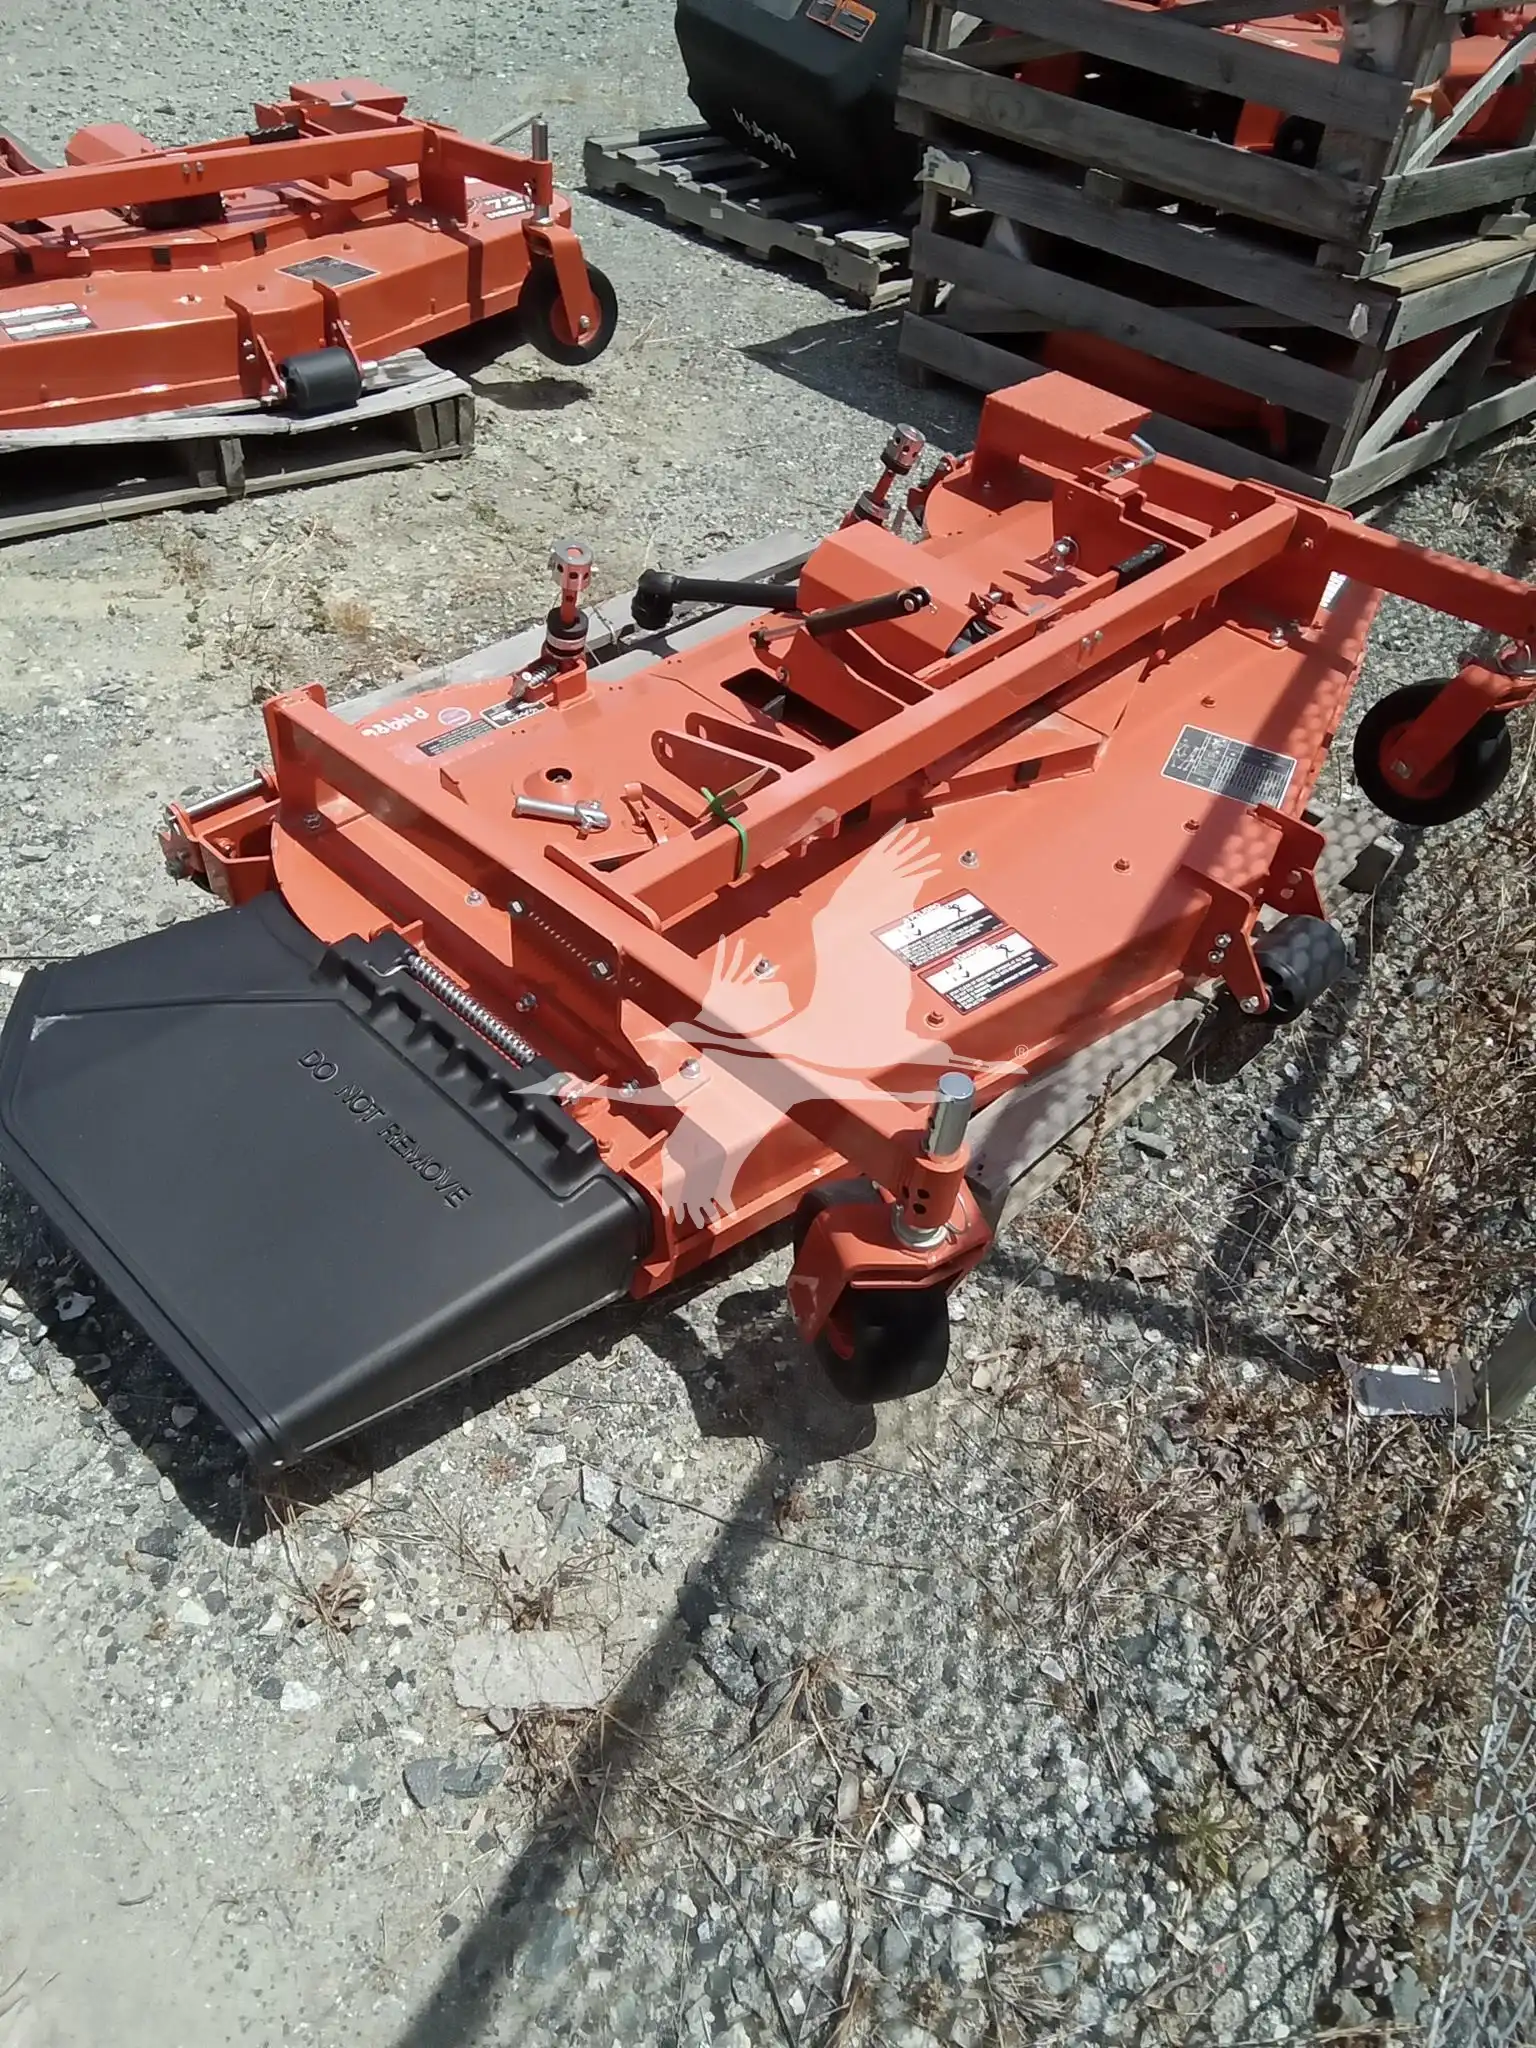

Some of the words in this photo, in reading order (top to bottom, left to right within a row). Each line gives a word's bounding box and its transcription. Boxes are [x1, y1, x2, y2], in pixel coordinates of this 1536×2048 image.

[298, 1048, 339, 1081] DO
[334, 1082, 386, 1123] NOT
[376, 1122, 472, 1208] REMOVE
